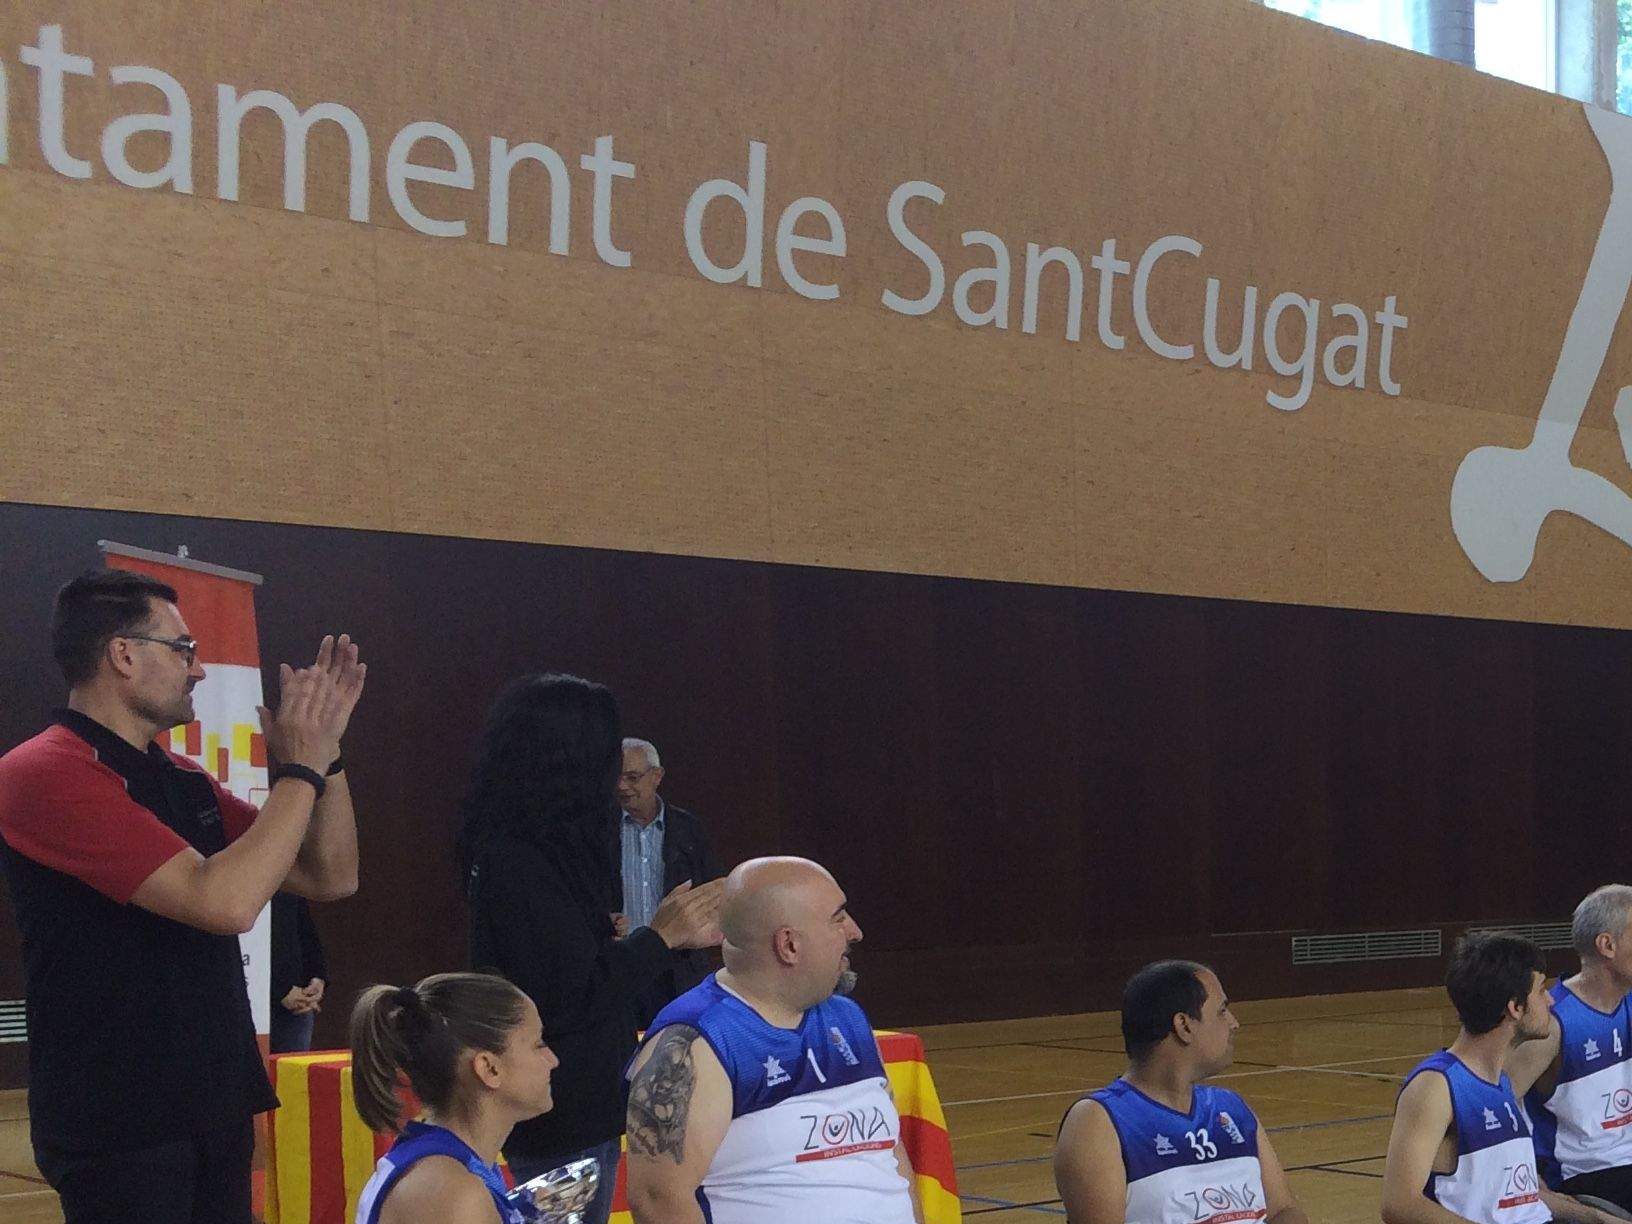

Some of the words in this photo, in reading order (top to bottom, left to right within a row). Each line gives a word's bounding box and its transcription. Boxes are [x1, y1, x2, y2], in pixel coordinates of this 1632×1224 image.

[0, 23, 637, 268] tament
[683, 140, 848, 301] de
[880, 180, 1409, 412] SantCugat
[807, 1047, 828, 1085] 1
[799, 1105, 892, 1151] ZONA
[1184, 1127, 1218, 1161] 33
